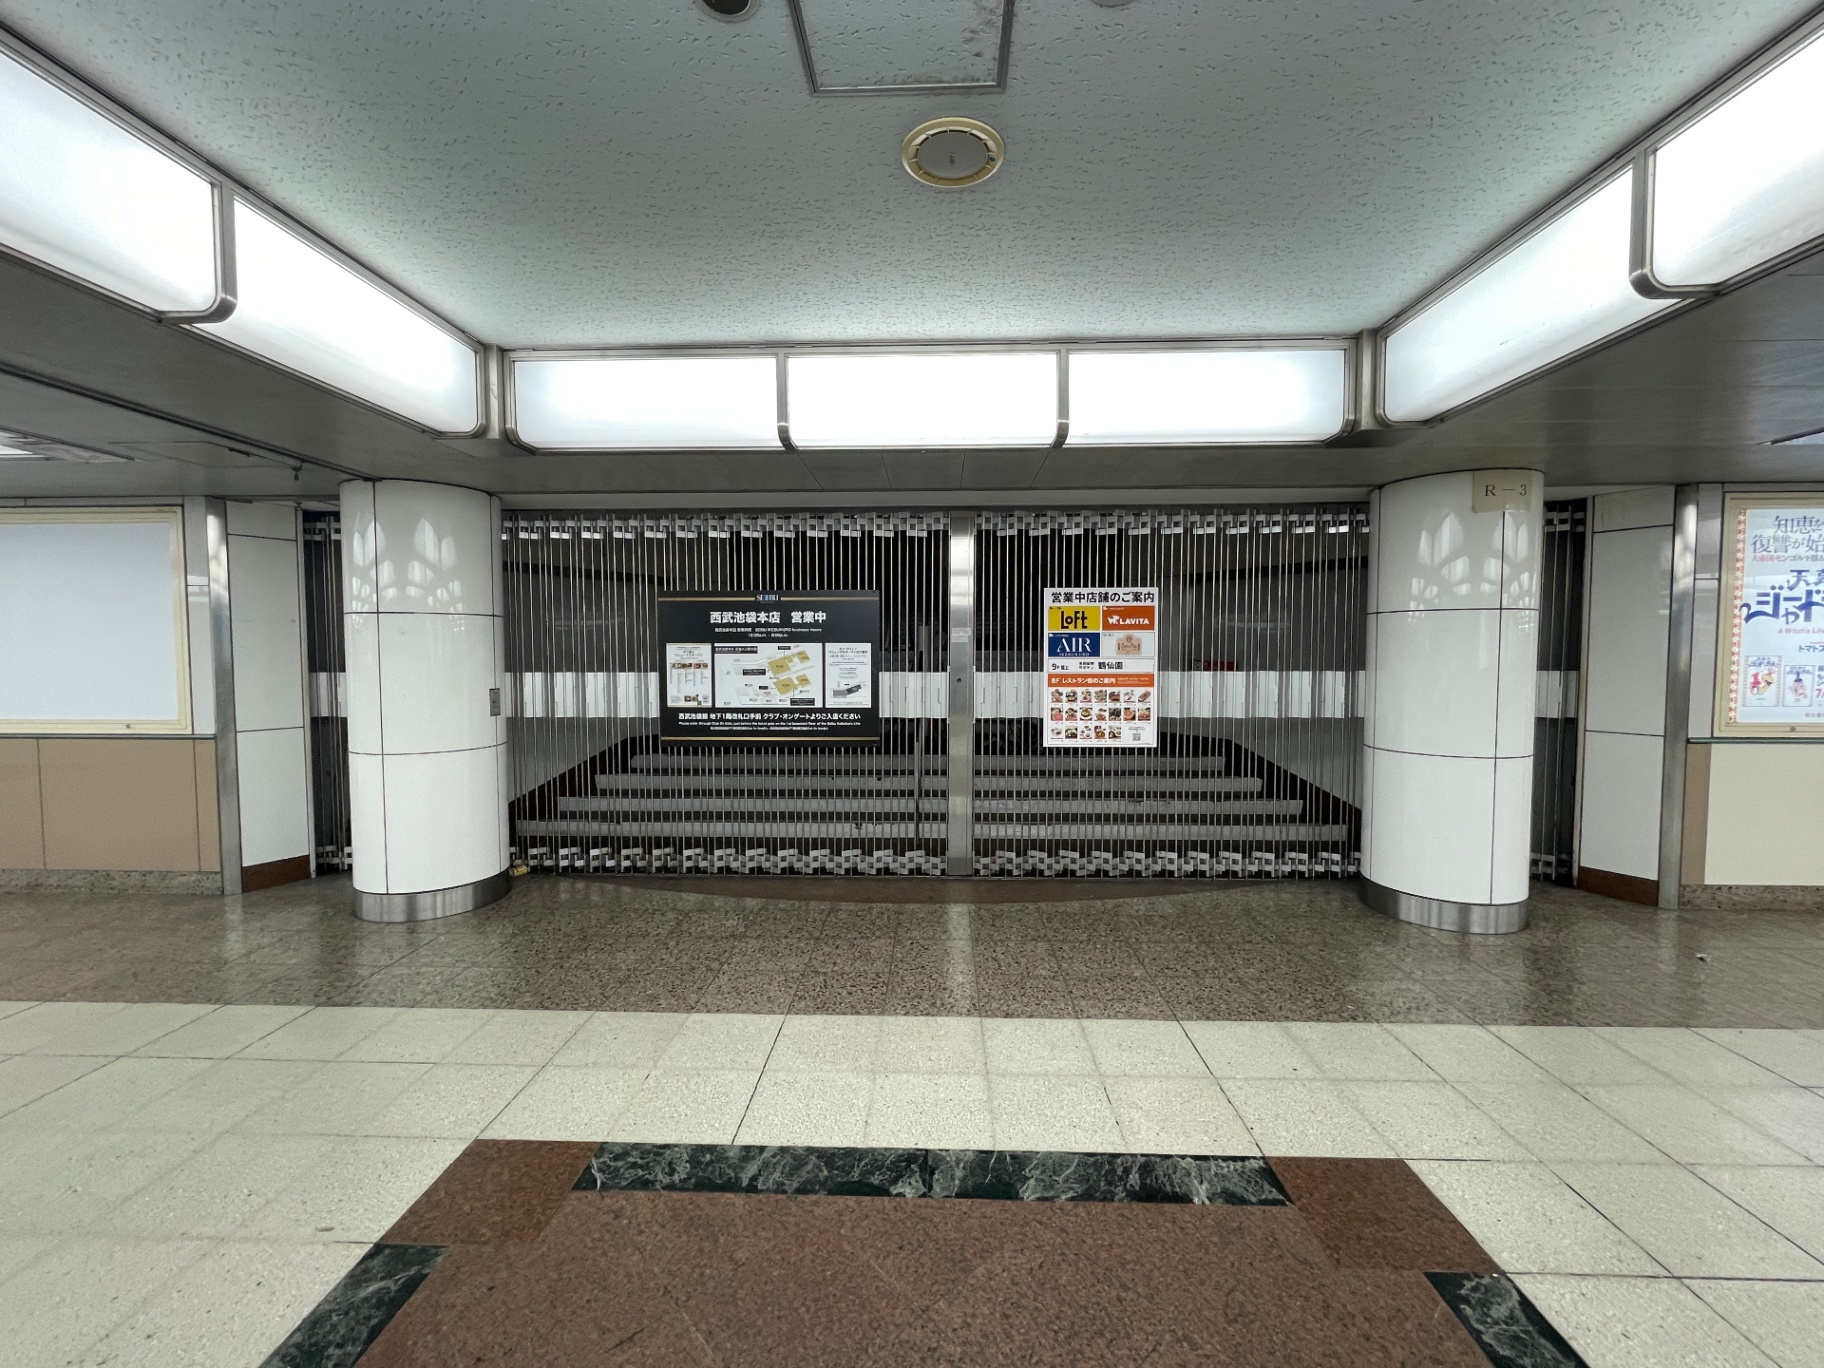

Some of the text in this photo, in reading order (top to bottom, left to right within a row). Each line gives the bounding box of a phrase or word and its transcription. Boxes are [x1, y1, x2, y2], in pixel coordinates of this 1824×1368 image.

[1051, 591, 1155, 603] 営業中店舗のご案内
[709, 611, 827, 624] 西武池袋本店 営業中
[1057, 638, 1092, 652] AIR
